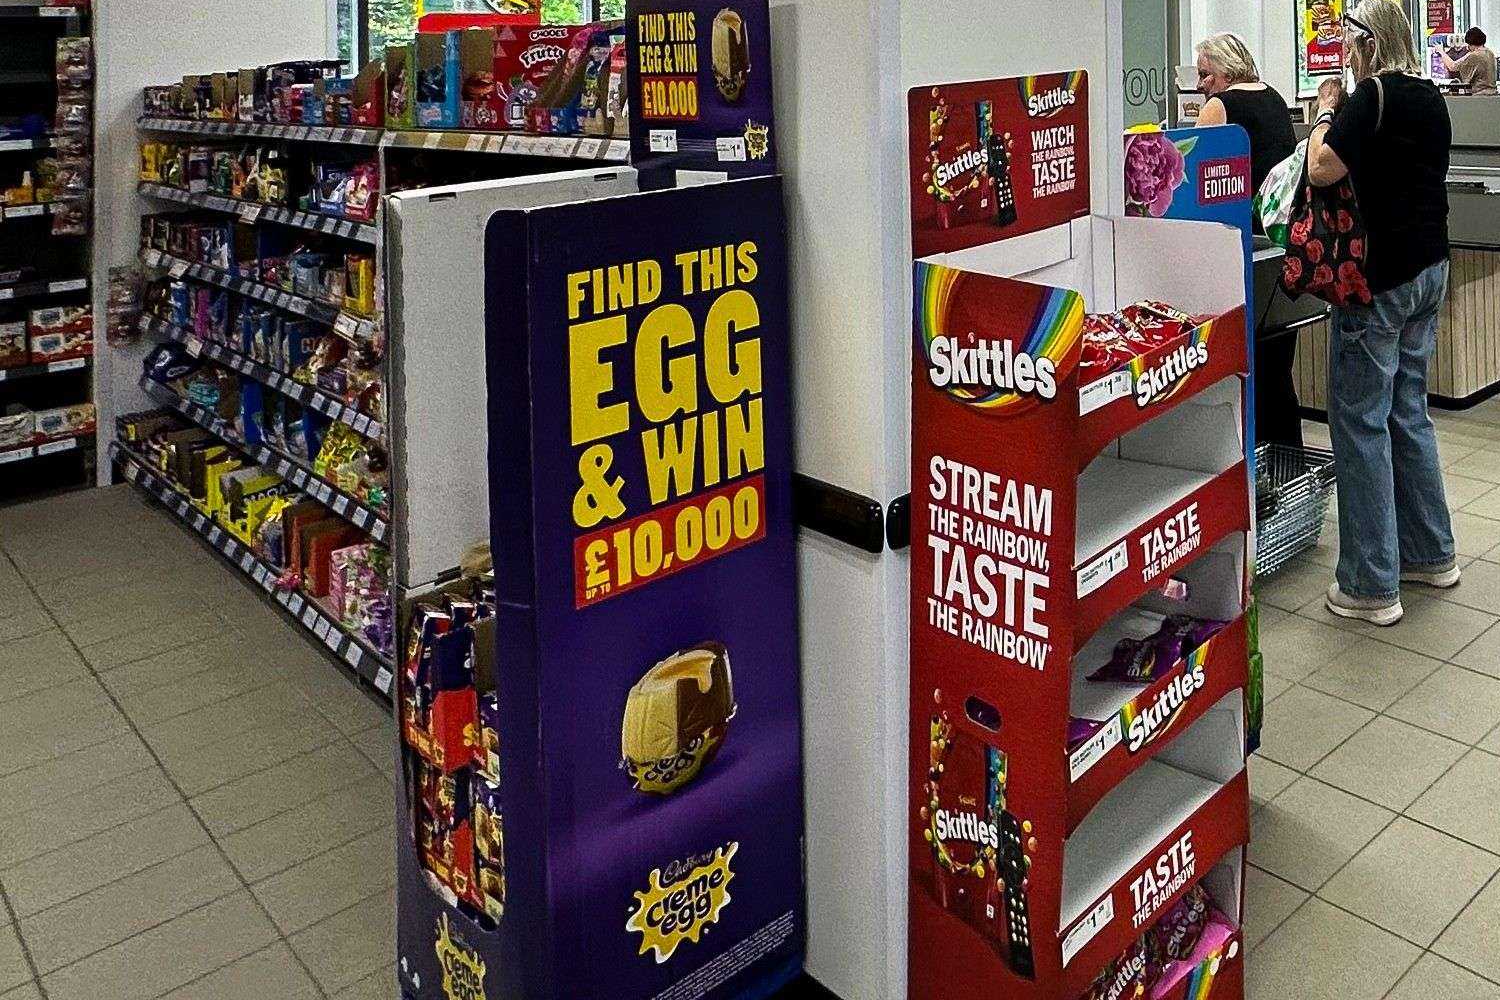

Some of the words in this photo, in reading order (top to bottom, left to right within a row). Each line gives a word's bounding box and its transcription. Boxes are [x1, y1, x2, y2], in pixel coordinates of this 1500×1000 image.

[638, 14, 665, 43] FIND
[667, 11, 696, 42] THIS
[640, 44, 662, 73] EGG
[664, 44, 674, 73] &
[673, 43, 698, 73] WIN
[1028, 86, 1076, 117] Skittles
[1031, 124, 1075, 151] WATCH
[1031, 151, 1044, 164] THE
[936, 148, 989, 187] Skittles
[1031, 156, 1076, 186] TASTE
[1032, 185, 1046, 199] THE
[1046, 179, 1076, 196] RAINBOW
[1203, 164, 1230, 179] LIMITED
[1204, 175, 1245, 199] EDITION
[567, 259, 662, 320] FIND
[675, 241, 758, 296] THIS
[569, 289, 763, 447] EGG
[929, 331, 1057, 399] Skittles
[1135, 341, 1209, 407] Skittles
[572, 443, 627, 529] &
[641, 397, 765, 506] WIN
[929, 455, 1053, 537] STREAM
[584, 486, 759, 590] £10,000
[928, 502, 960, 540] THE
[962, 515, 1051, 573] RAINBOW,
[1139, 501, 1201, 567] TASTE
[1141, 560, 1161, 584] THE
[1160, 531, 1202, 572] RAINBOW
[585, 588, 597, 600] UP
[601, 583, 611, 595] TO
[928, 533, 1050, 639] TASTE
[927, 597, 959, 637] THE
[961, 611, 1049, 671] RAINBOW
[1128, 664, 1206, 752] Skittles
[935, 807, 999, 849] Skittles
[663, 849, 714, 884] Cadbury
[1129, 830, 1195, 913] TASTE
[1131, 909, 1153, 929] THE
[1152, 858, 1197, 913] RAINBOW
[646, 867, 724, 929] creme
[660, 890, 712, 936] egg
